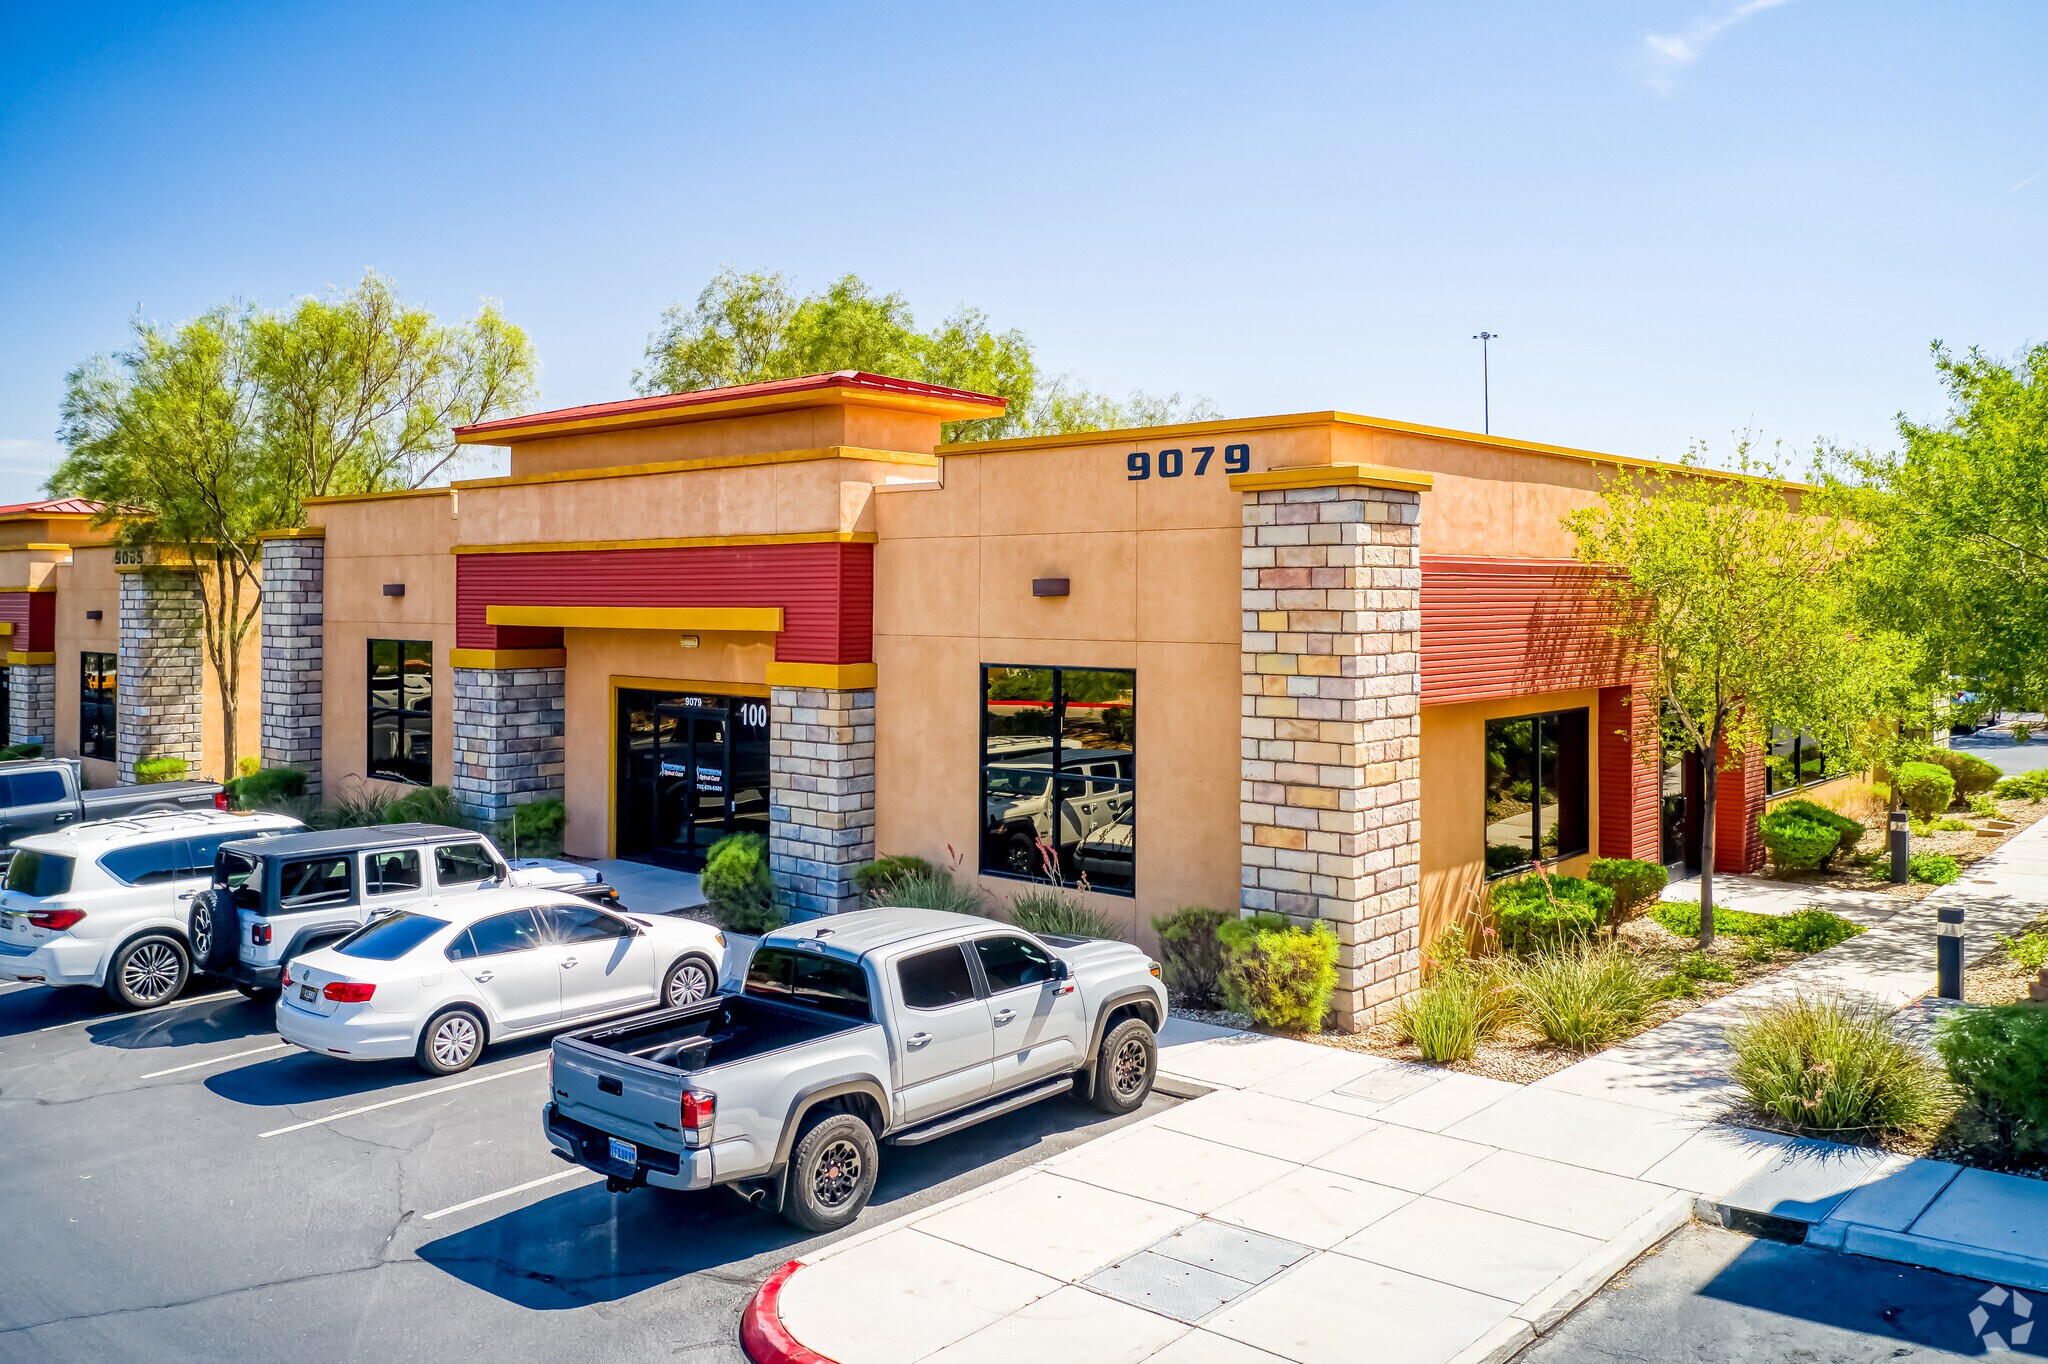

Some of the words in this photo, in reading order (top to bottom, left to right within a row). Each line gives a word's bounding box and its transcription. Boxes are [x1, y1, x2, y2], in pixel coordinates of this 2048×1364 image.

[1127, 443, 1250, 481] 9079
[685, 697, 703, 707] 9079
[740, 703, 767, 728] 100
